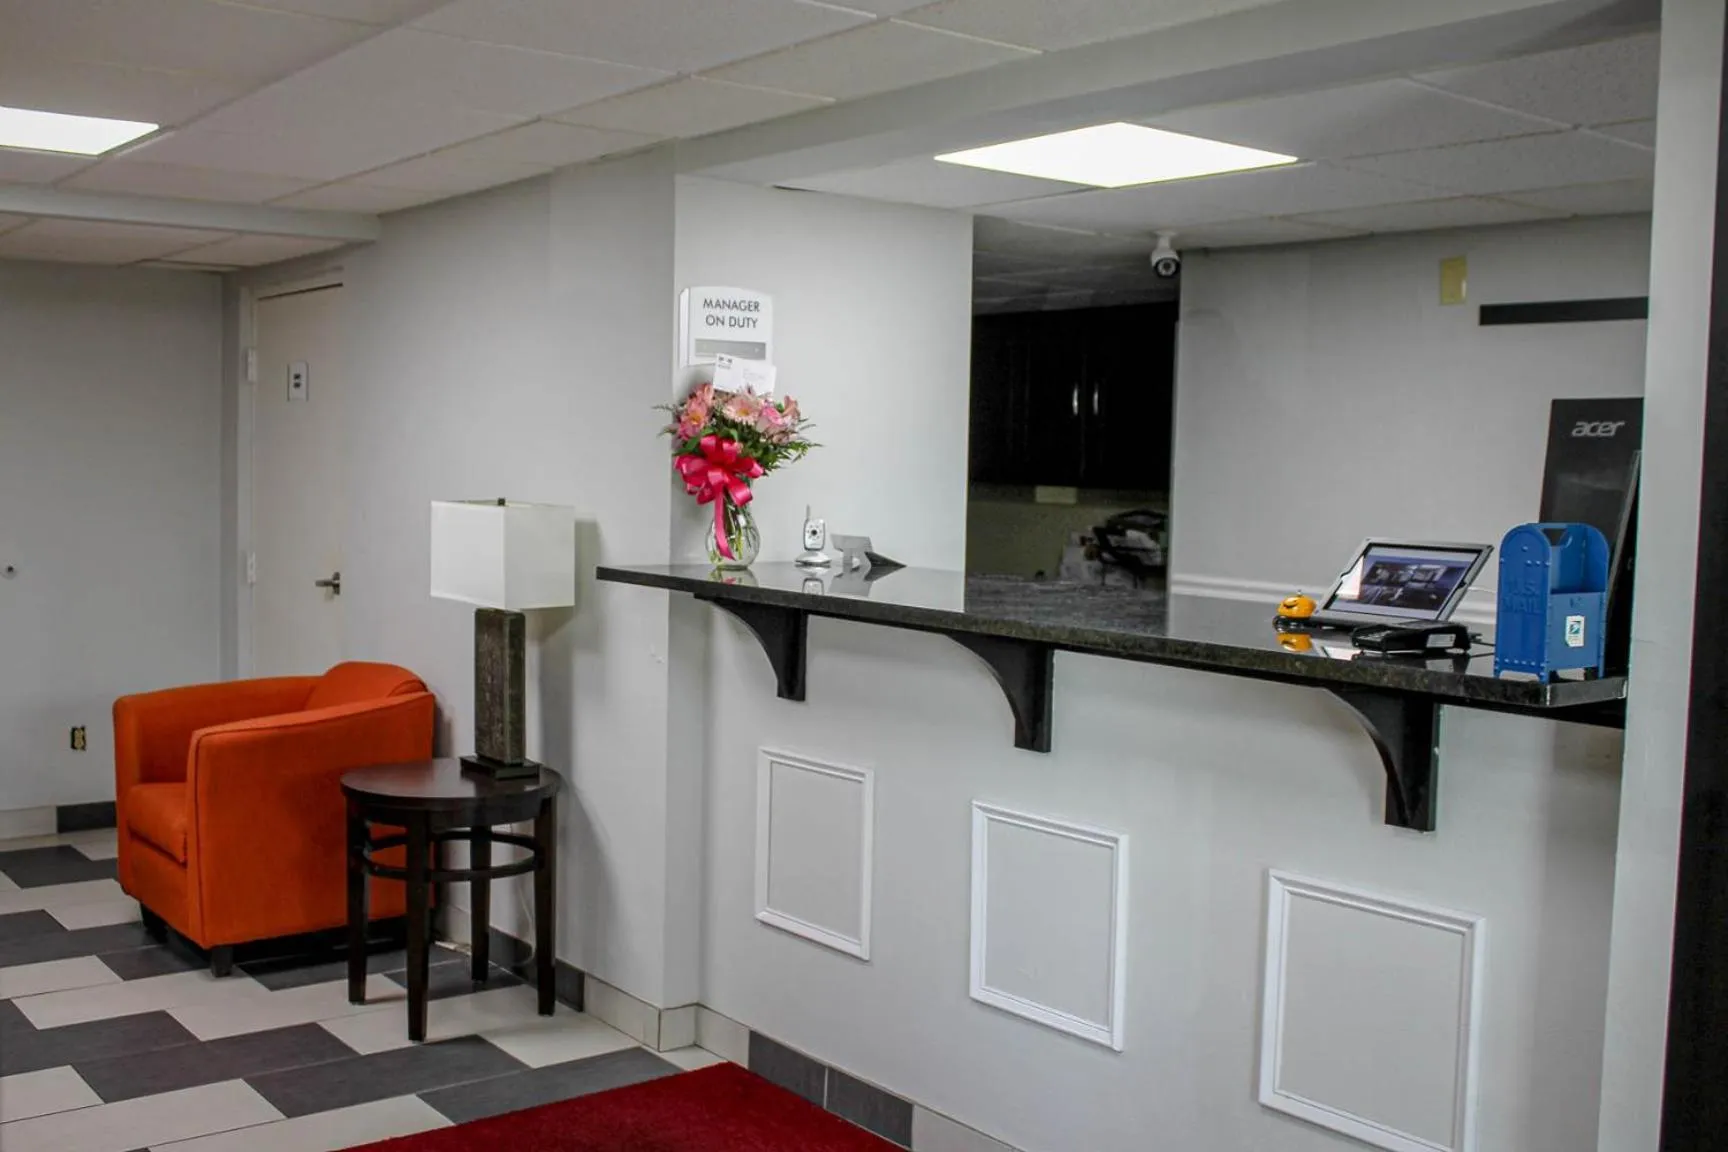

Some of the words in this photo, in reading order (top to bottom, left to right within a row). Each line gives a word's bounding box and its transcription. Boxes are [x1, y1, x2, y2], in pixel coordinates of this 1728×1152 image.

[703, 298, 760, 312] MANAGER
[705, 314, 725, 327] ON
[728, 315, 759, 329] DUTY
[1571, 420, 1625, 437] acer
[1502, 597, 1541, 613] MAIL
